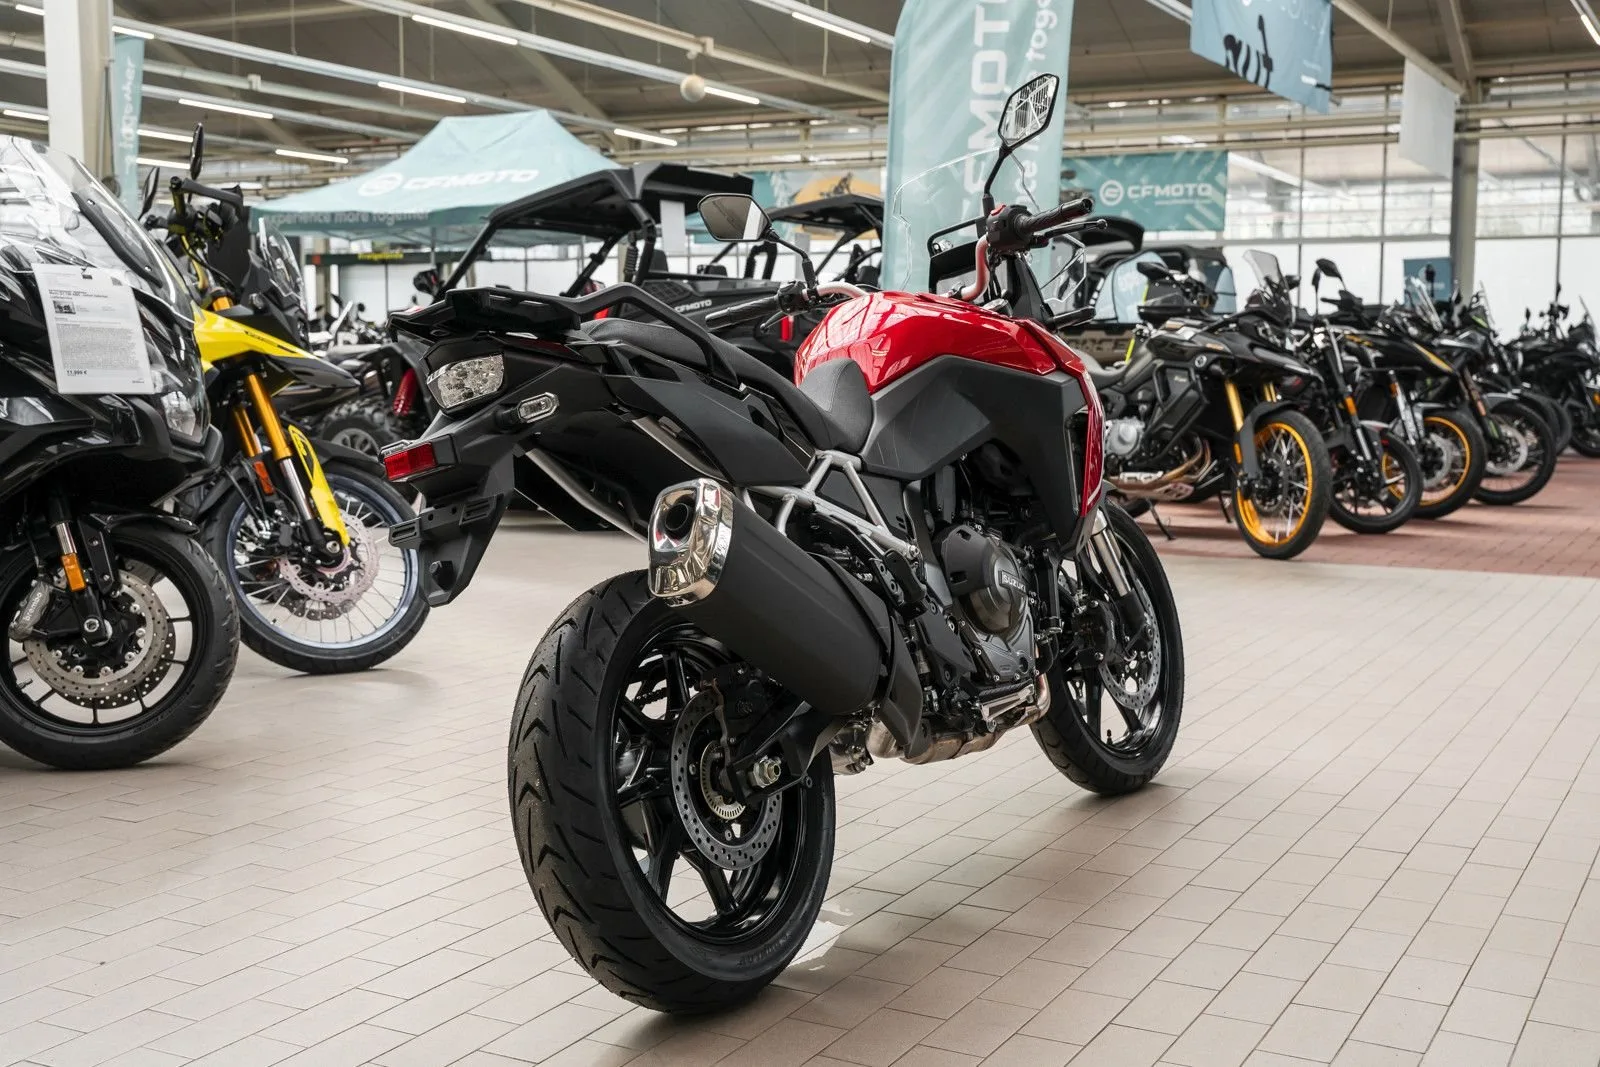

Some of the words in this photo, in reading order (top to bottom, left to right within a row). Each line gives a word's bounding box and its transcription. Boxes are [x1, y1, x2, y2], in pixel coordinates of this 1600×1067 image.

[402, 169, 539, 189] CFMOTO
[1127, 183, 1212, 199] CFMOTO
[674, 299, 712, 313] CFMOTO
[1003, 574, 1026, 593] SUZUKI
[23, 592, 42, 621] brembo
